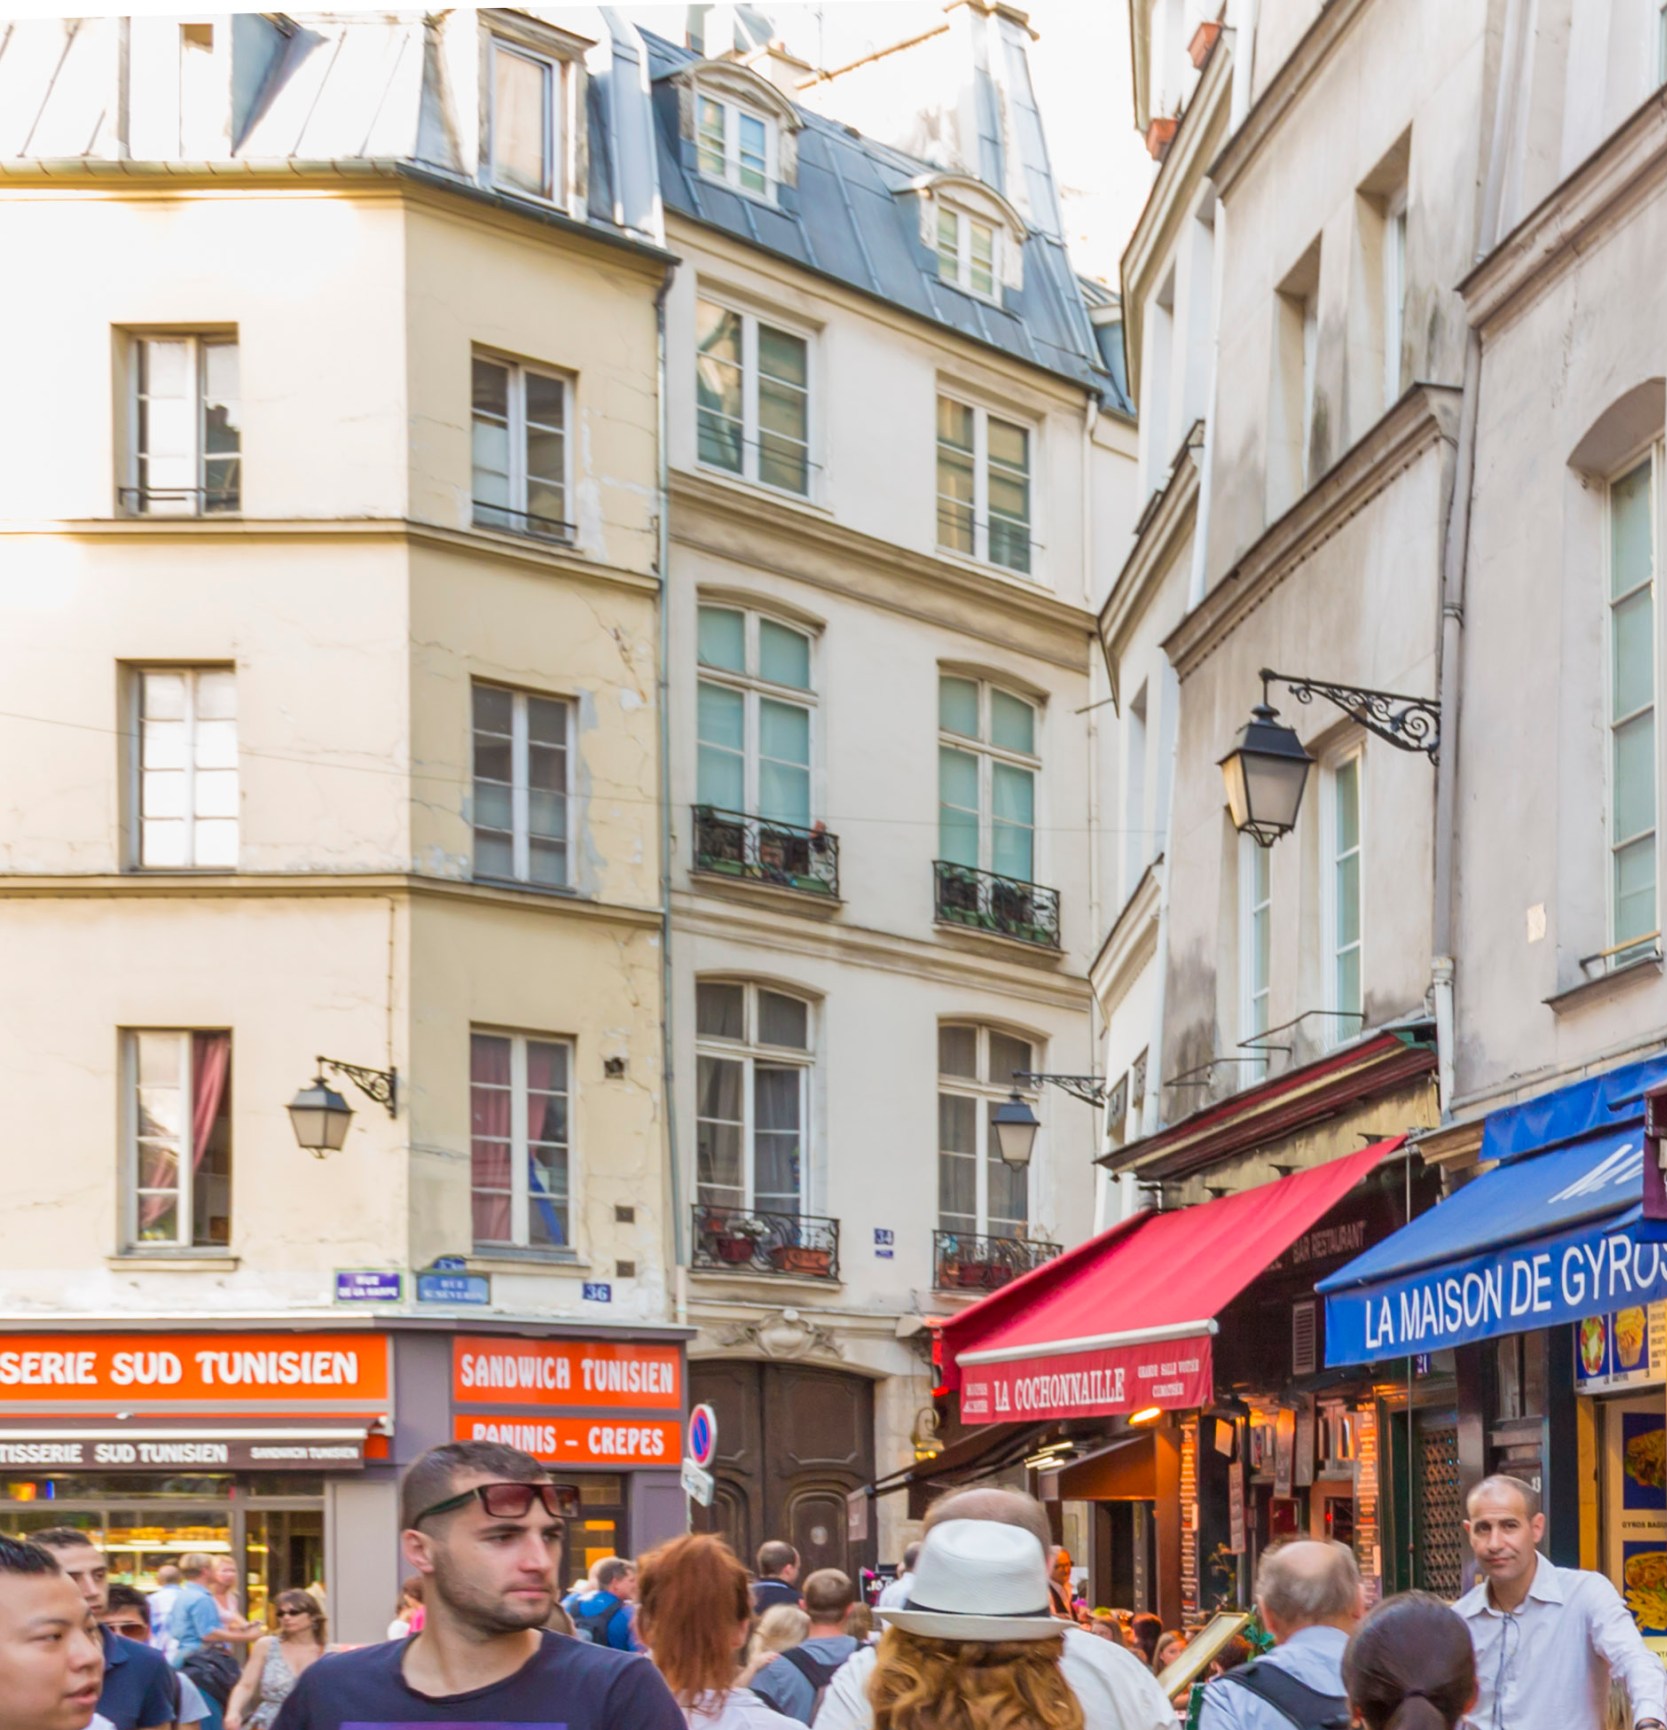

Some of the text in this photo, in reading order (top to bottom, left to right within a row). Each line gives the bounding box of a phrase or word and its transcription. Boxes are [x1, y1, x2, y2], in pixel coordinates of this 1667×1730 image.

[585, 1284, 608, 1301] 36
[1365, 1291, 1395, 1349] LA
[1400, 1264, 1503, 1342] MAISON
[1510, 1253, 1552, 1318] DE
[110, 1351, 182, 1385] SUD
[195, 1351, 358, 1384] TUNISIEN
[461, 1354, 673, 1394] SANDWICH TUNISIEN
[993, 1381, 1010, 1412] LA
[1014, 1367, 1126, 1412] COCHONNAILLE
[94, 1443, 136, 1464] SUD
[138, 1443, 229, 1464] TUNISIEN
[250, 1446, 359, 1460] SANDWICH TUNISIEN
[588, 1426, 665, 1456] CREPES
